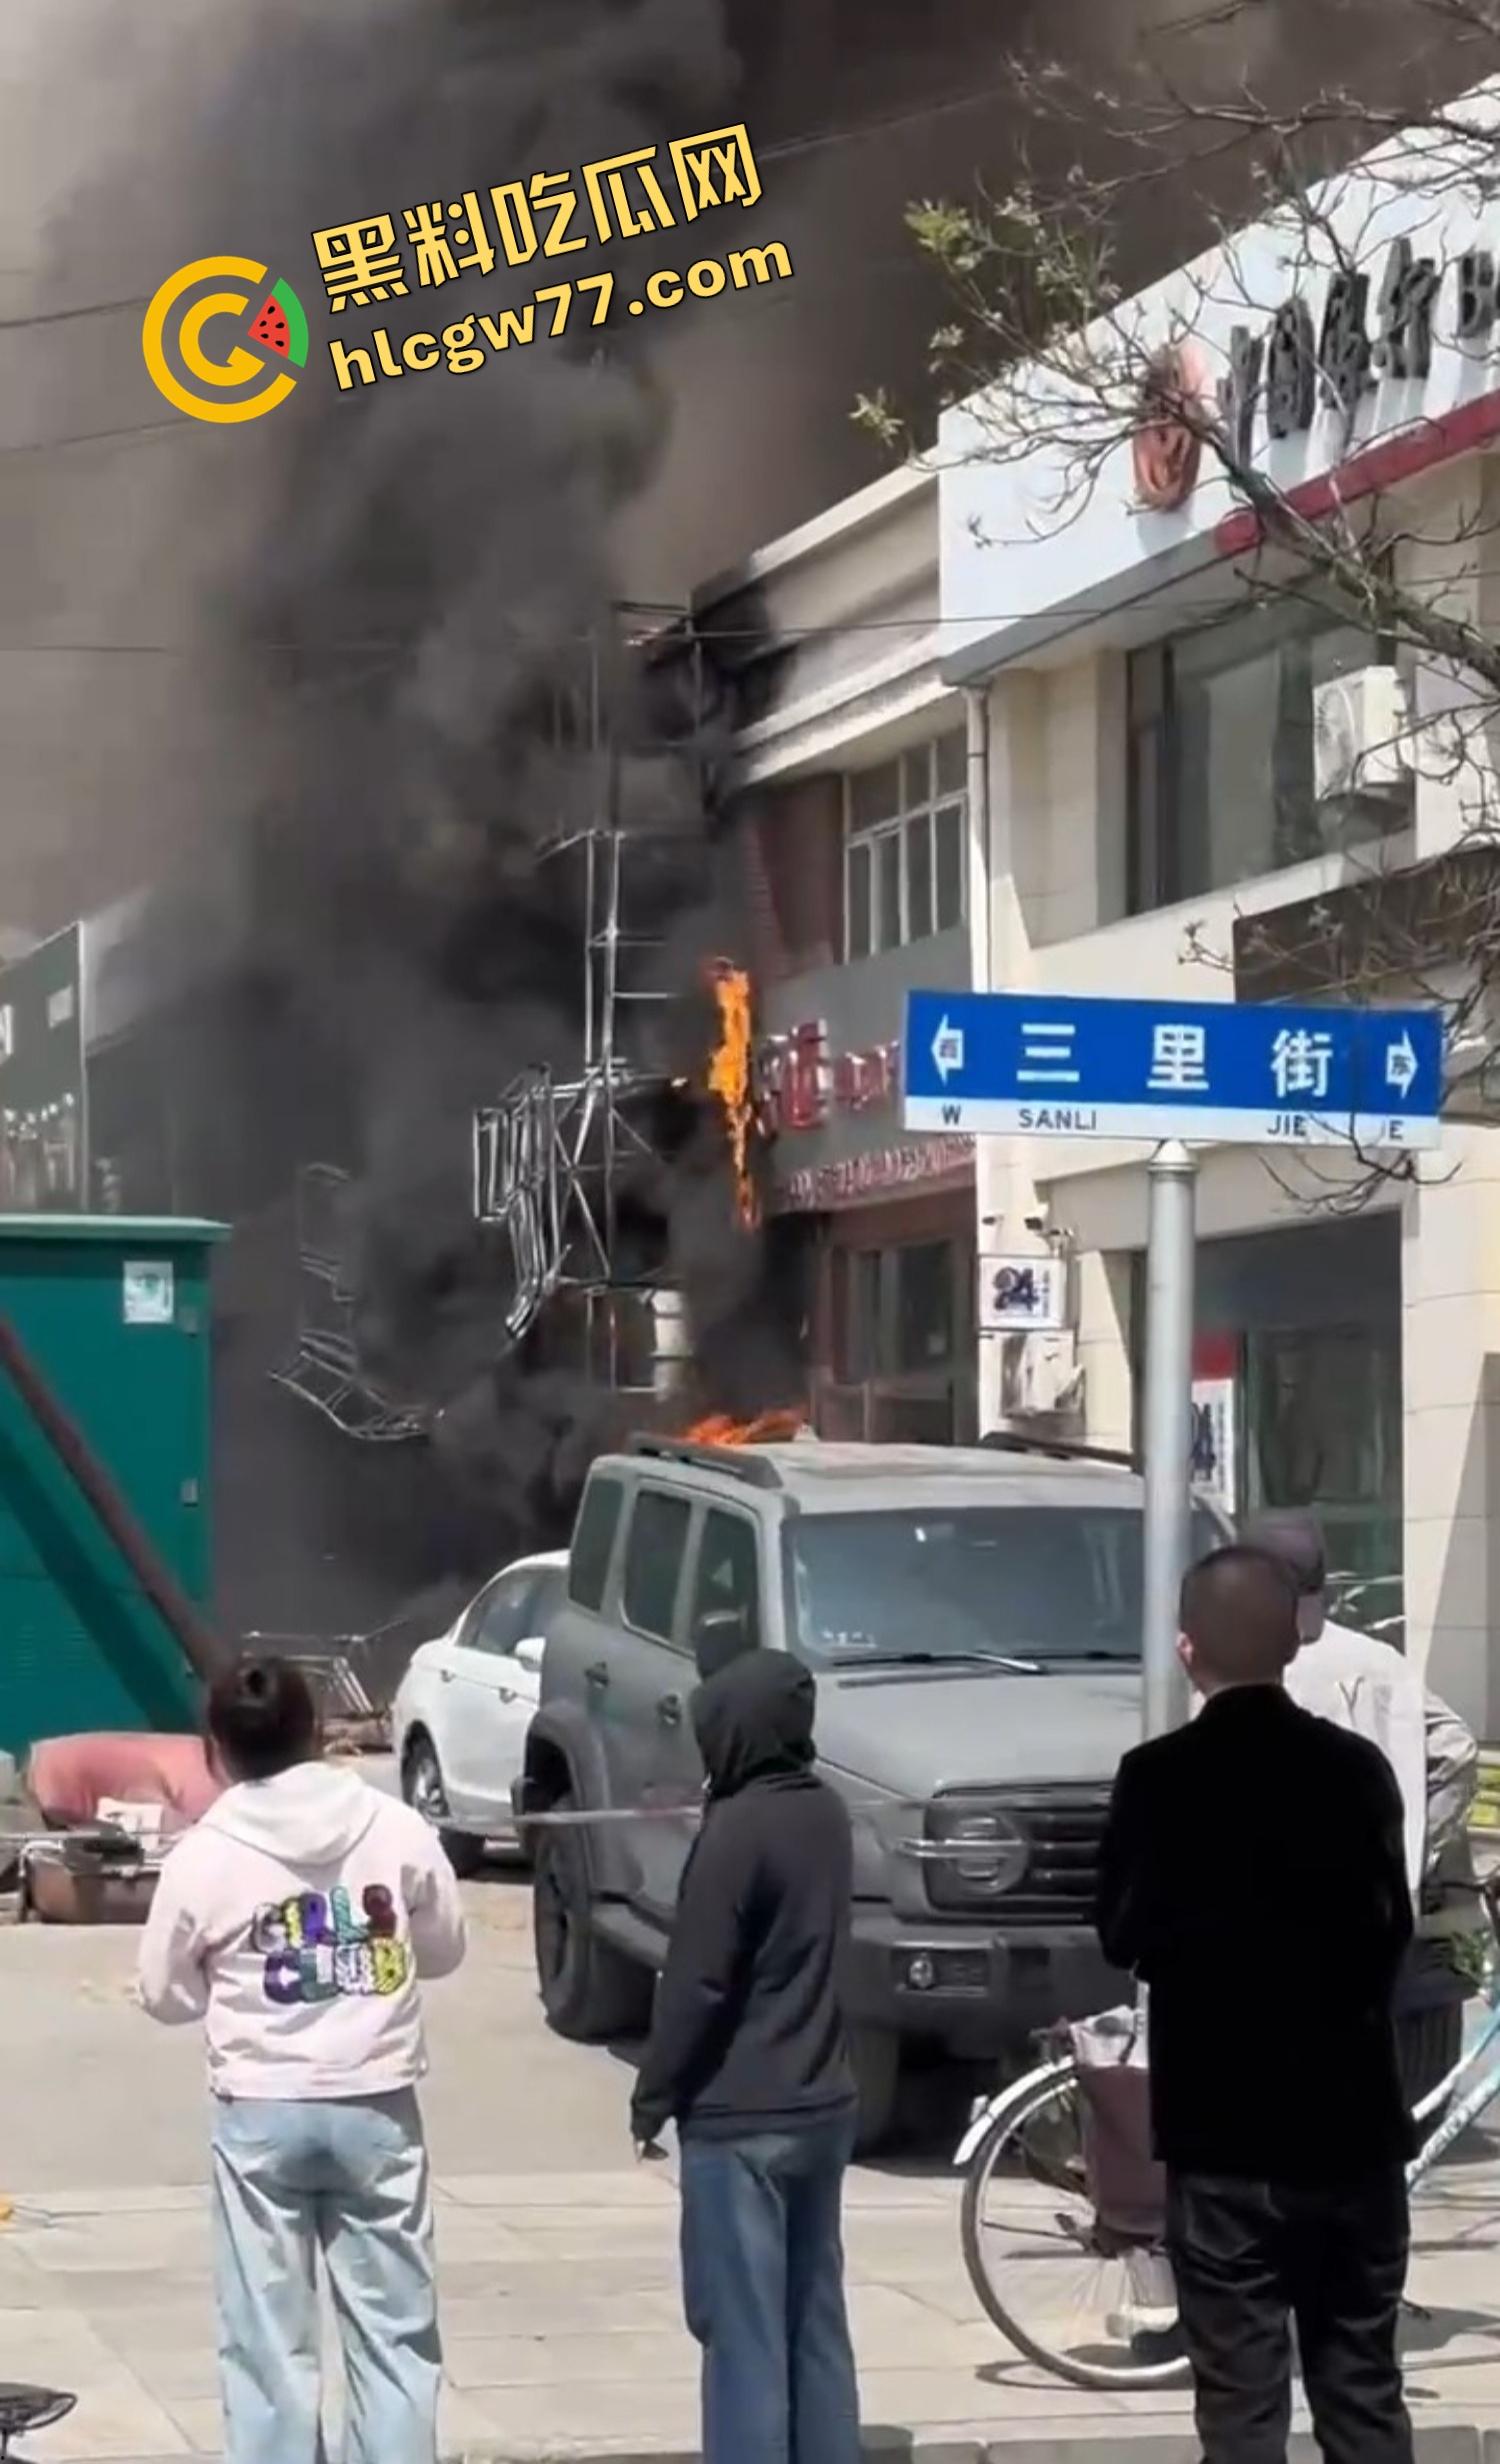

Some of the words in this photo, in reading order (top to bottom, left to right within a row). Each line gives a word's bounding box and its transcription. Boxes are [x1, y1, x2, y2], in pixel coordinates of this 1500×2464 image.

[1016, 1023, 1334, 1099] 三里街
[941, 1104, 962, 1125] W
[1018, 1108, 1098, 1131] SANLI
[1267, 1115, 1306, 1137] JIE
[1389, 1119, 1404, 1140] E
[993, 1265, 1040, 1312] 24
